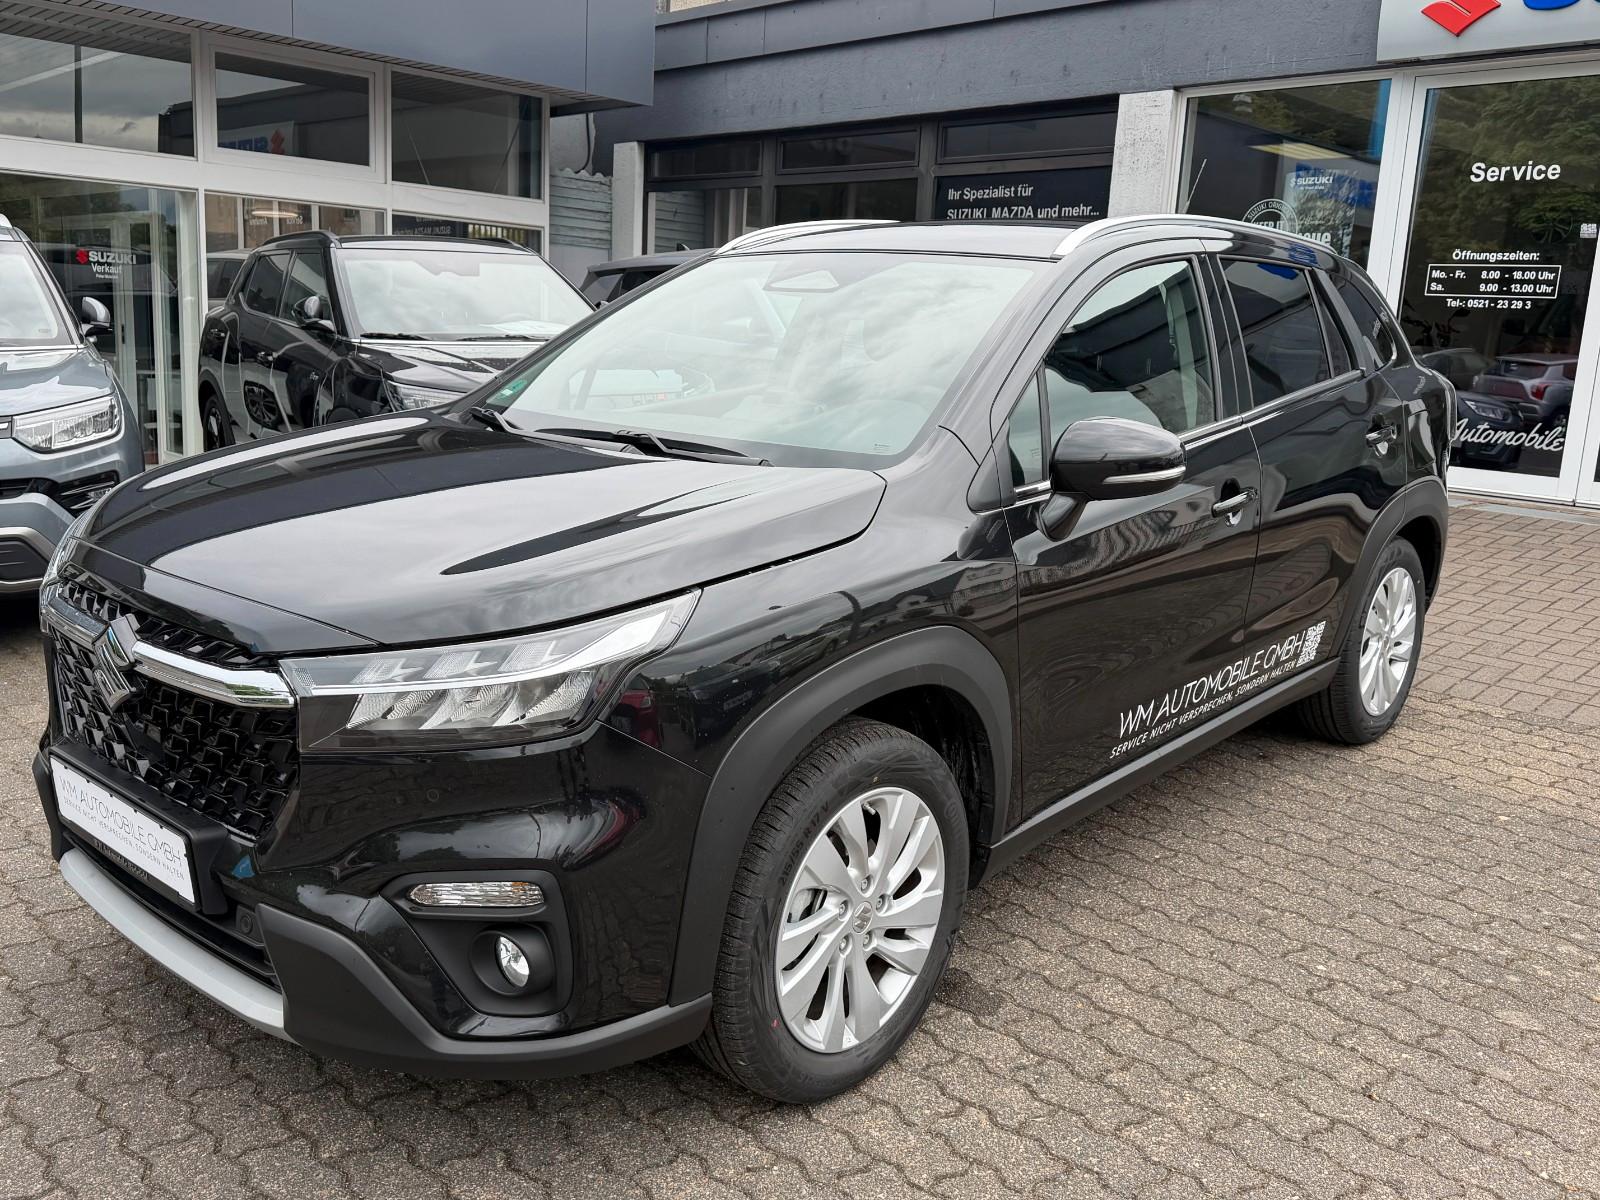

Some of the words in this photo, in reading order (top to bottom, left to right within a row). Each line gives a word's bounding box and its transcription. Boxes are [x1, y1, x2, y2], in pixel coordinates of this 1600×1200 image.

[1470, 161, 1561, 182] Service
[1297, 176, 1333, 185] SUZUKI
[948, 188, 962, 200] Ihr
[963, 185, 1015, 201] Spezialist
[1017, 184, 1034, 197] für
[947, 208, 987, 219] SUZUKI
[992, 206, 1034, 218] MAZDA
[1037, 205, 1059, 218] und
[1062, 204, 1100, 217] mehr...
[88, 250, 136, 265] SUZUKI
[1452, 249, 1539, 262] Öffnungszeiten:
[91, 263, 122, 274] Verkauf
[1431, 270, 1447, 279] Mo.
[1455, 270, 1466, 279] Fr.
[1481, 270, 1500, 279] 8.00
[1512, 271, 1536, 280] 18.00
[1538, 271, 1555, 280] Uhr
[1430, 282, 1445, 291] Sa.
[1479, 284, 1498, 292] 9.00
[1510, 284, 1533, 293] 13.00
[1536, 284, 1553, 293] Uhr
[1467, 299, 1489, 308] 0521
[1497, 300, 1508, 309] 23
[1511, 300, 1522, 309] 29
[1525, 300, 1531, 309] 3
[1120, 699, 1154, 739] WM
[1152, 649, 1265, 727] AUTOMOBILE
[1263, 630, 1306, 669] GMBH
[1109, 731, 1149, 759] SERVICE
[1149, 718, 1178, 740] NICHT
[1235, 672, 1270, 697] SONDERN
[1270, 659, 1296, 680] HALTEN
[80, 789, 146, 847] AUTOMOBILE
